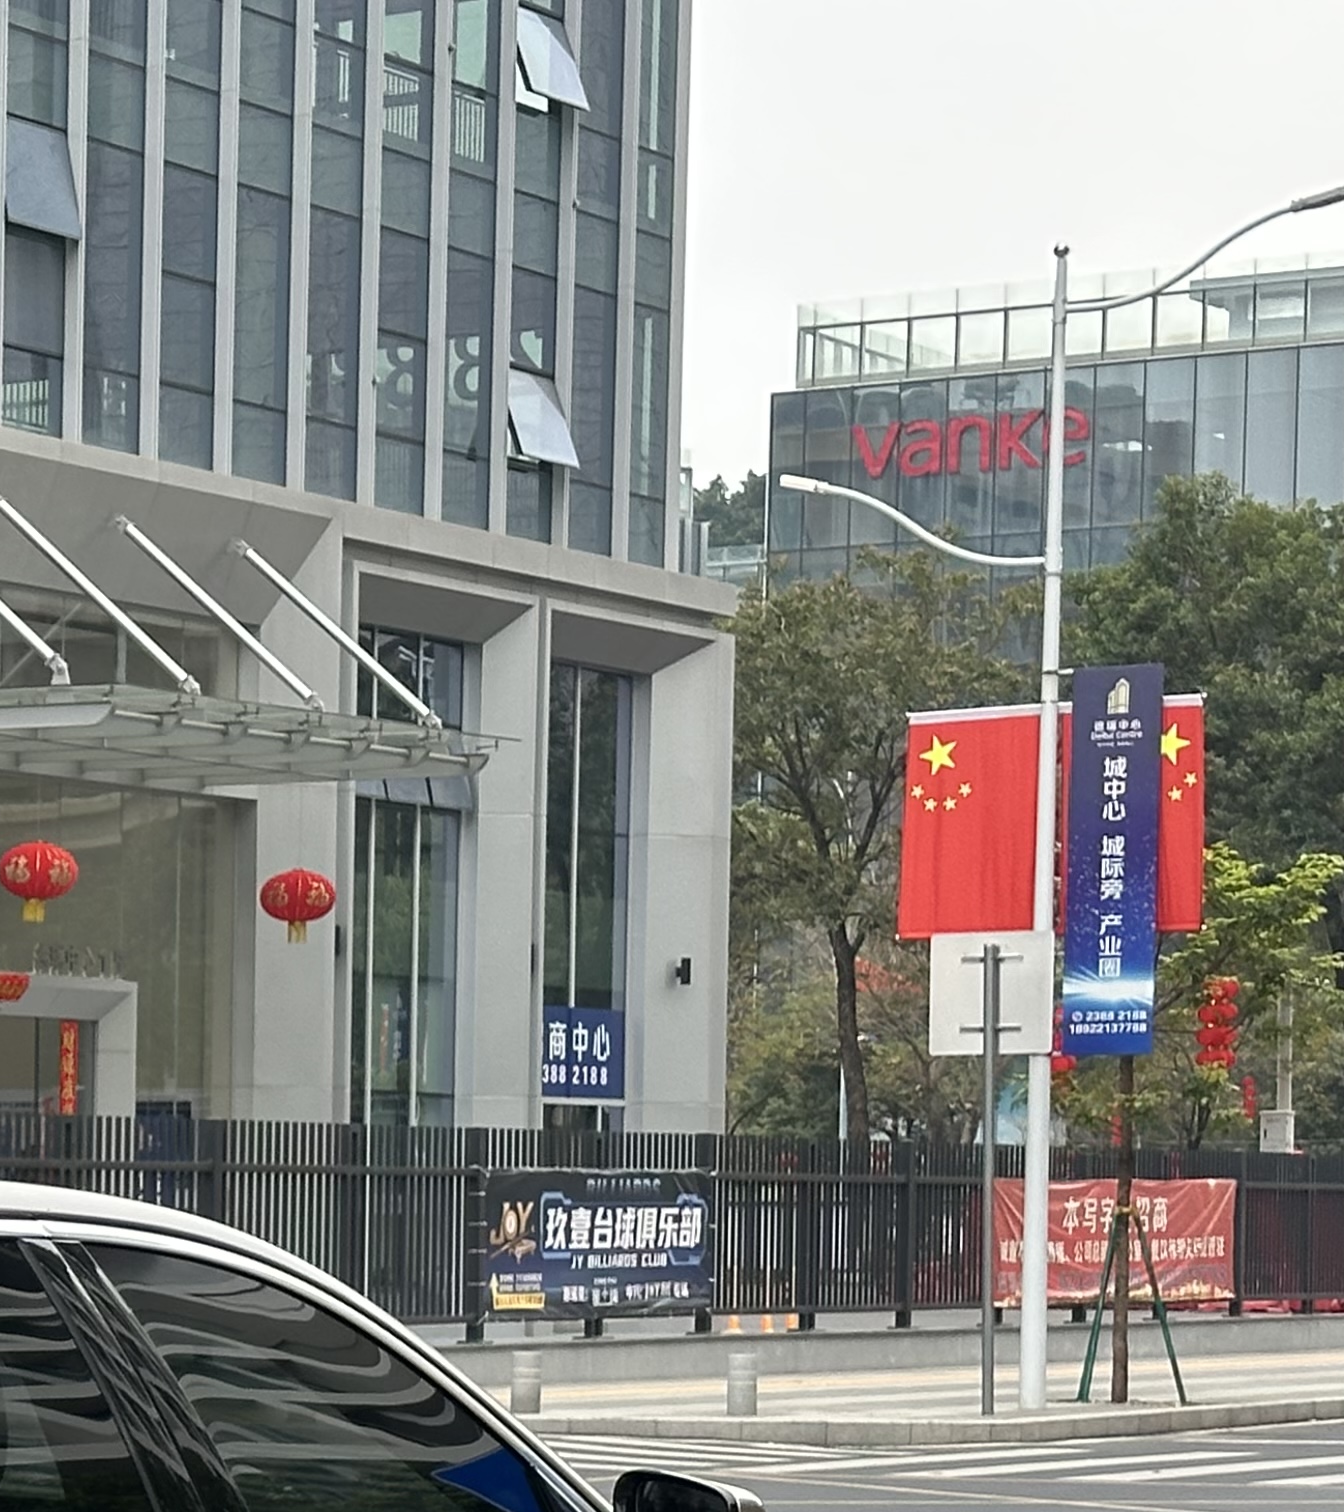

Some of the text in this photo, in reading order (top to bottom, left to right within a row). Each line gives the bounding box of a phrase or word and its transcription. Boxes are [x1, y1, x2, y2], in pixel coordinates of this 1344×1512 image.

[852, 405, 1091, 479] vanke
[1102, 756, 1127, 821] 城中心
[1100, 835, 1125, 900] 城际旁
[1098, 914, 1123, 978] 产业园
[548, 1020, 611, 1063] 商中心
[572, 1064, 608, 1086] 2188
[544, 1206, 702, 1250] 玖壹台球俱乐部
[1062, 1195, 1169, 1236] 本写字招商
